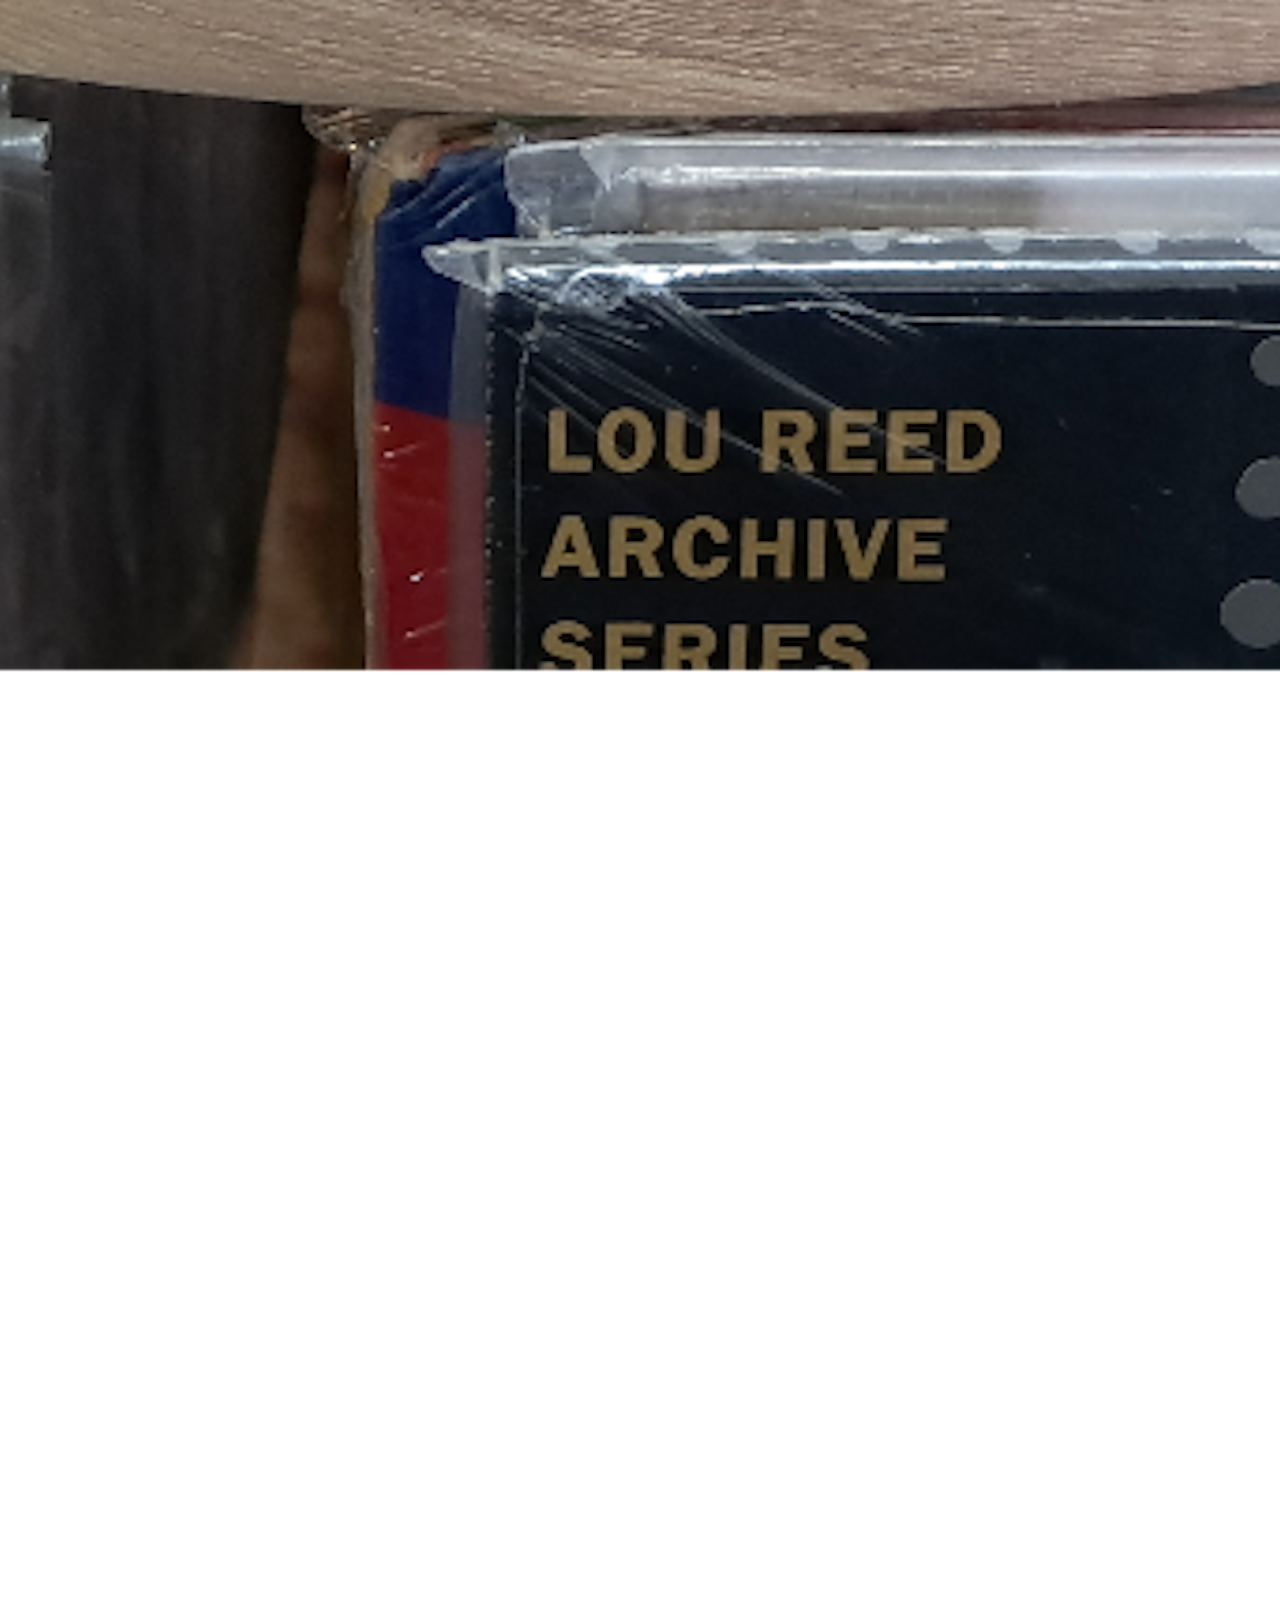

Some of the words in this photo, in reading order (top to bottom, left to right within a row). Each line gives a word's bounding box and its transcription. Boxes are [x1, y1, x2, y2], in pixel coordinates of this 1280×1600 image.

[547, 408, 719, 473] LOU
[761, 408, 1003, 474] REED
[540, 514, 948, 581] ARCHIVE
[539, 620, 872, 672] SERIES
